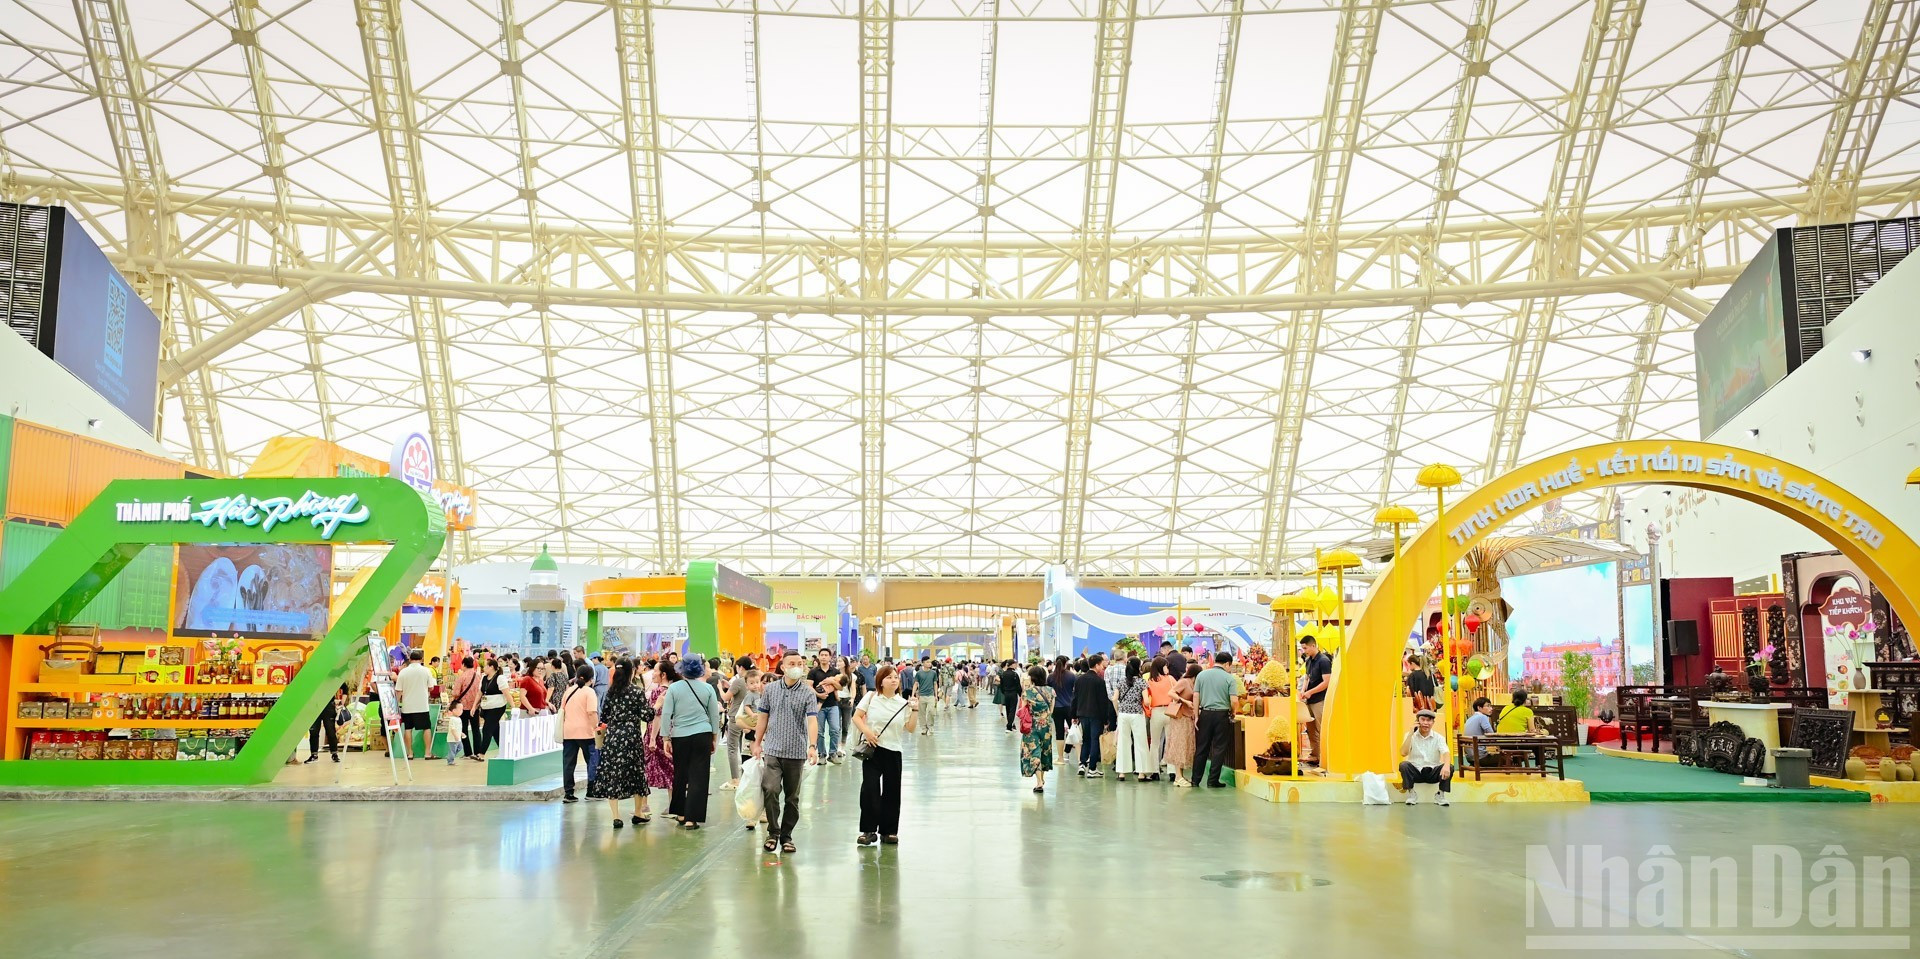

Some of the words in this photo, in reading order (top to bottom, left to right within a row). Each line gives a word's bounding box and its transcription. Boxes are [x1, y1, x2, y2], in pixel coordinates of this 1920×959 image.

[115, 497, 161, 522] THÀNH
[162, 495, 193, 522] PHỐ
[250, 489, 371, 540] Phòng
[1449, 504, 1498, 546] TINH
[1495, 482, 1541, 516] HOA
[1539, 457, 1585, 494] HUẾ
[1598, 447, 1639, 478] KẾT
[1642, 445, 1678, 472] NỐI
[1681, 454, 1702, 473] DI
[1705, 452, 1750, 483] SẢN
[1753, 466, 1784, 493] VÀ
[1784, 482, 1843, 521] SÁNG
[1842, 510, 1886, 550] TẠO
